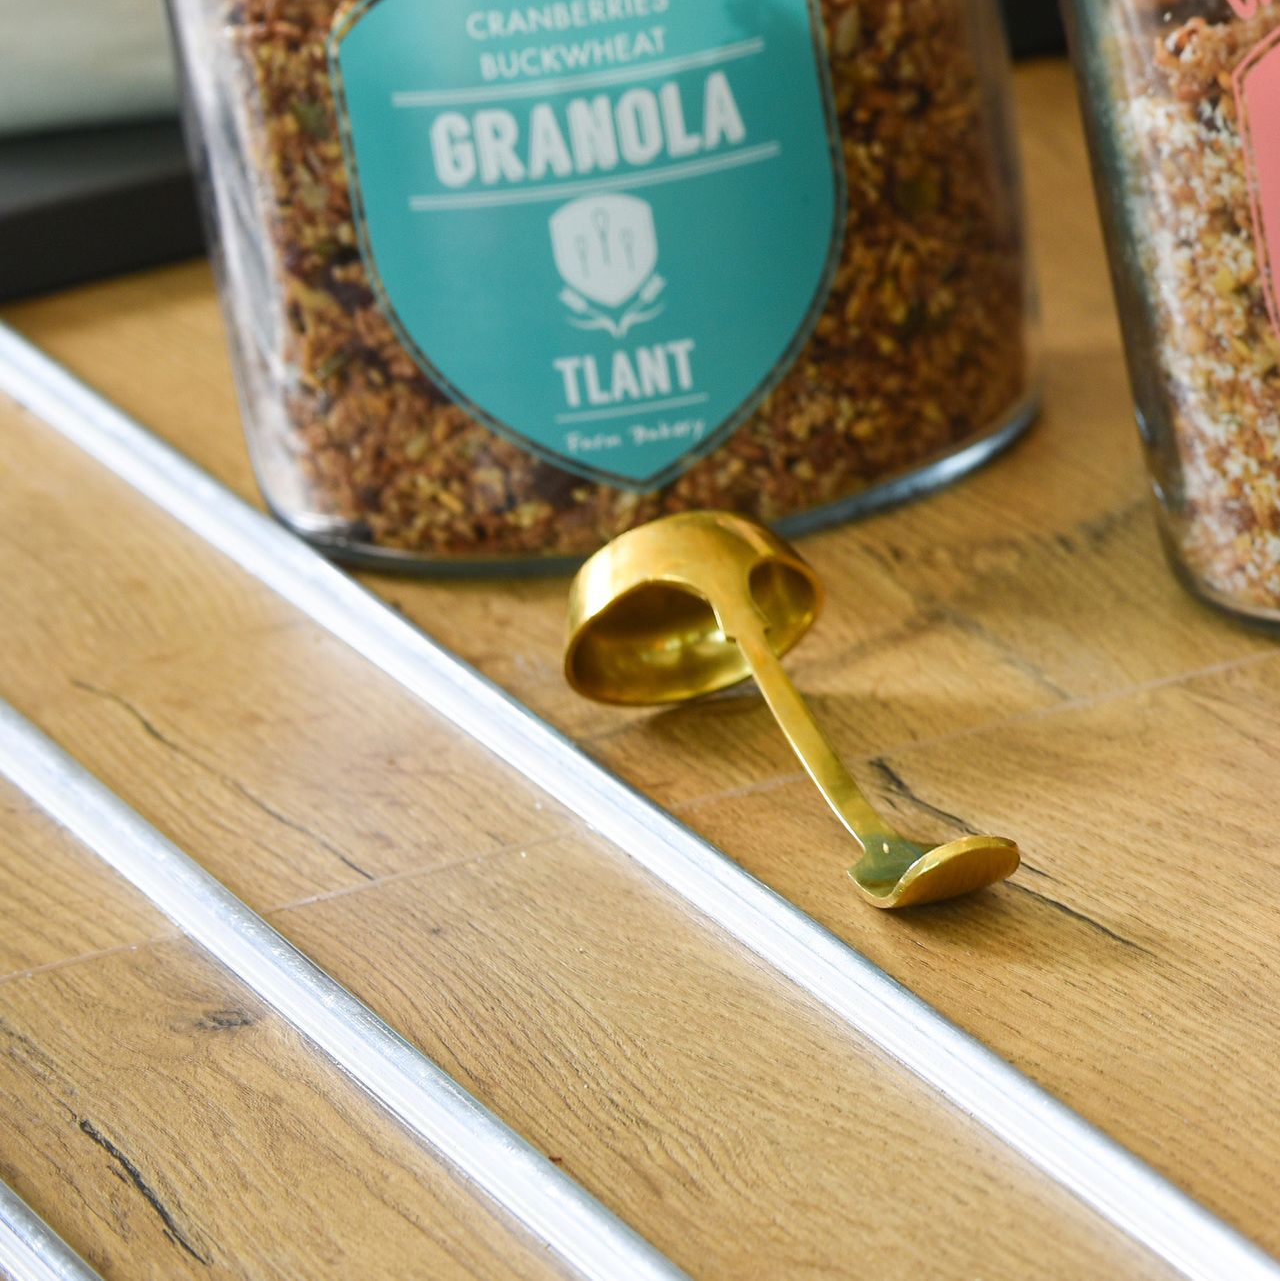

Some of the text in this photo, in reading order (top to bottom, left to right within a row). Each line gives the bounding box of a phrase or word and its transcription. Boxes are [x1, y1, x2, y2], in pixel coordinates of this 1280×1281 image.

[479, 28, 667, 81] BUCKWHEAT
[429, 70, 747, 189] GRANOLA
[553, 339, 695, 408] TLANT
